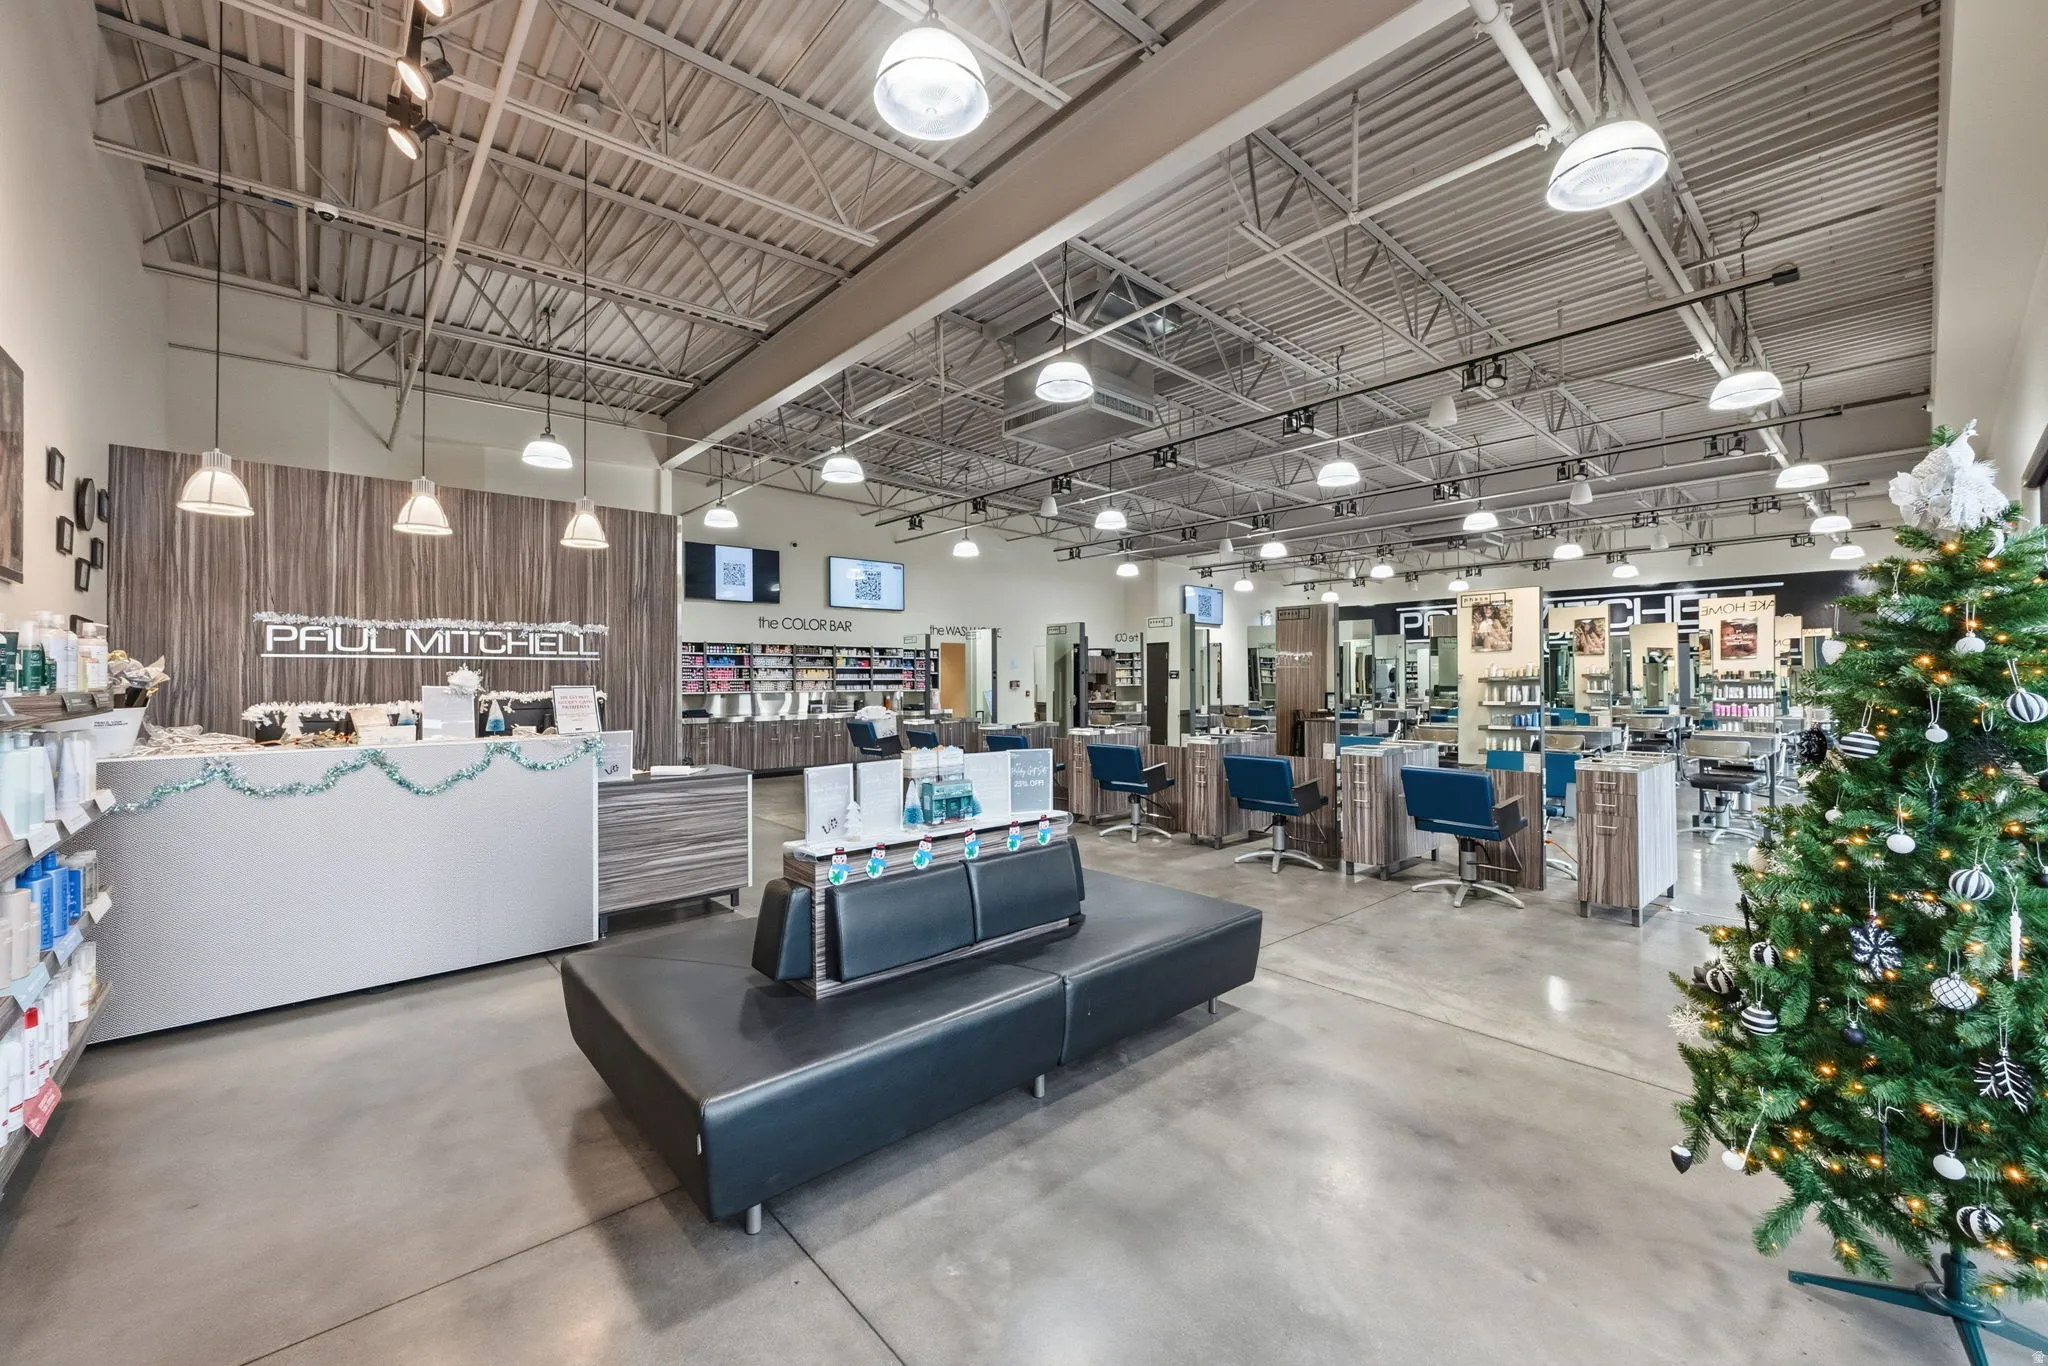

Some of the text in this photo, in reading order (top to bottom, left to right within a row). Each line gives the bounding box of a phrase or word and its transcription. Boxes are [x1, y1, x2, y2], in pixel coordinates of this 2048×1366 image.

[758, 616, 852, 632] the COLOR BAR
[929, 625, 945, 636] the
[266, 625, 600, 656] PAUL MITCHELL
